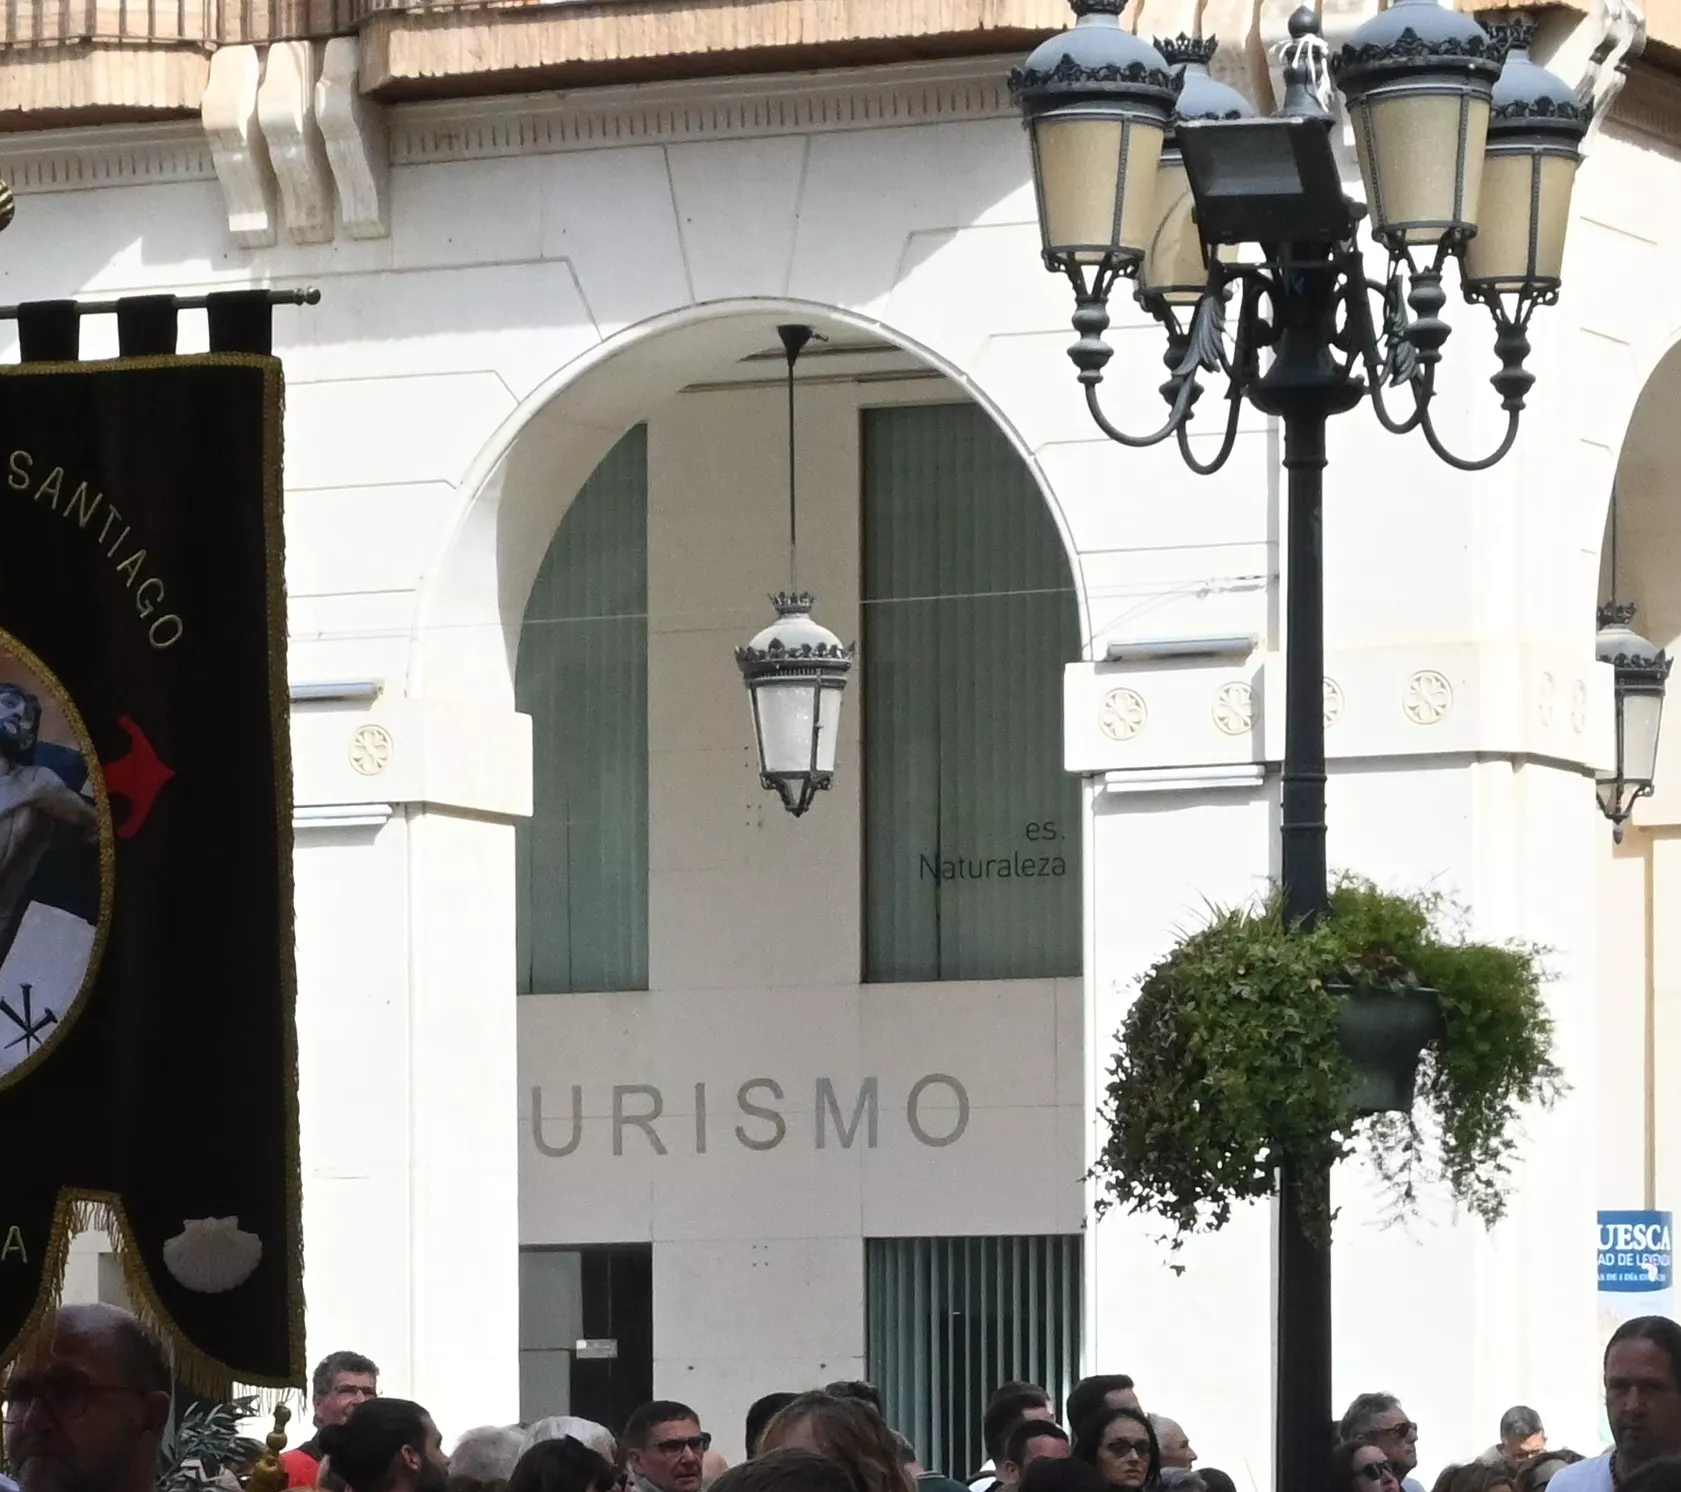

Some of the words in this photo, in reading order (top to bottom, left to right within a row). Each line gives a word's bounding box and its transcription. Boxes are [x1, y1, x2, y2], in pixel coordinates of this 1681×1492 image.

[7, 449, 184, 649] SANTIAGO
[920, 850, 1067, 881] Naturaleza
[531, 1072, 970, 1159] URISMO
[1617, 1253, 1634, 1266] DE
